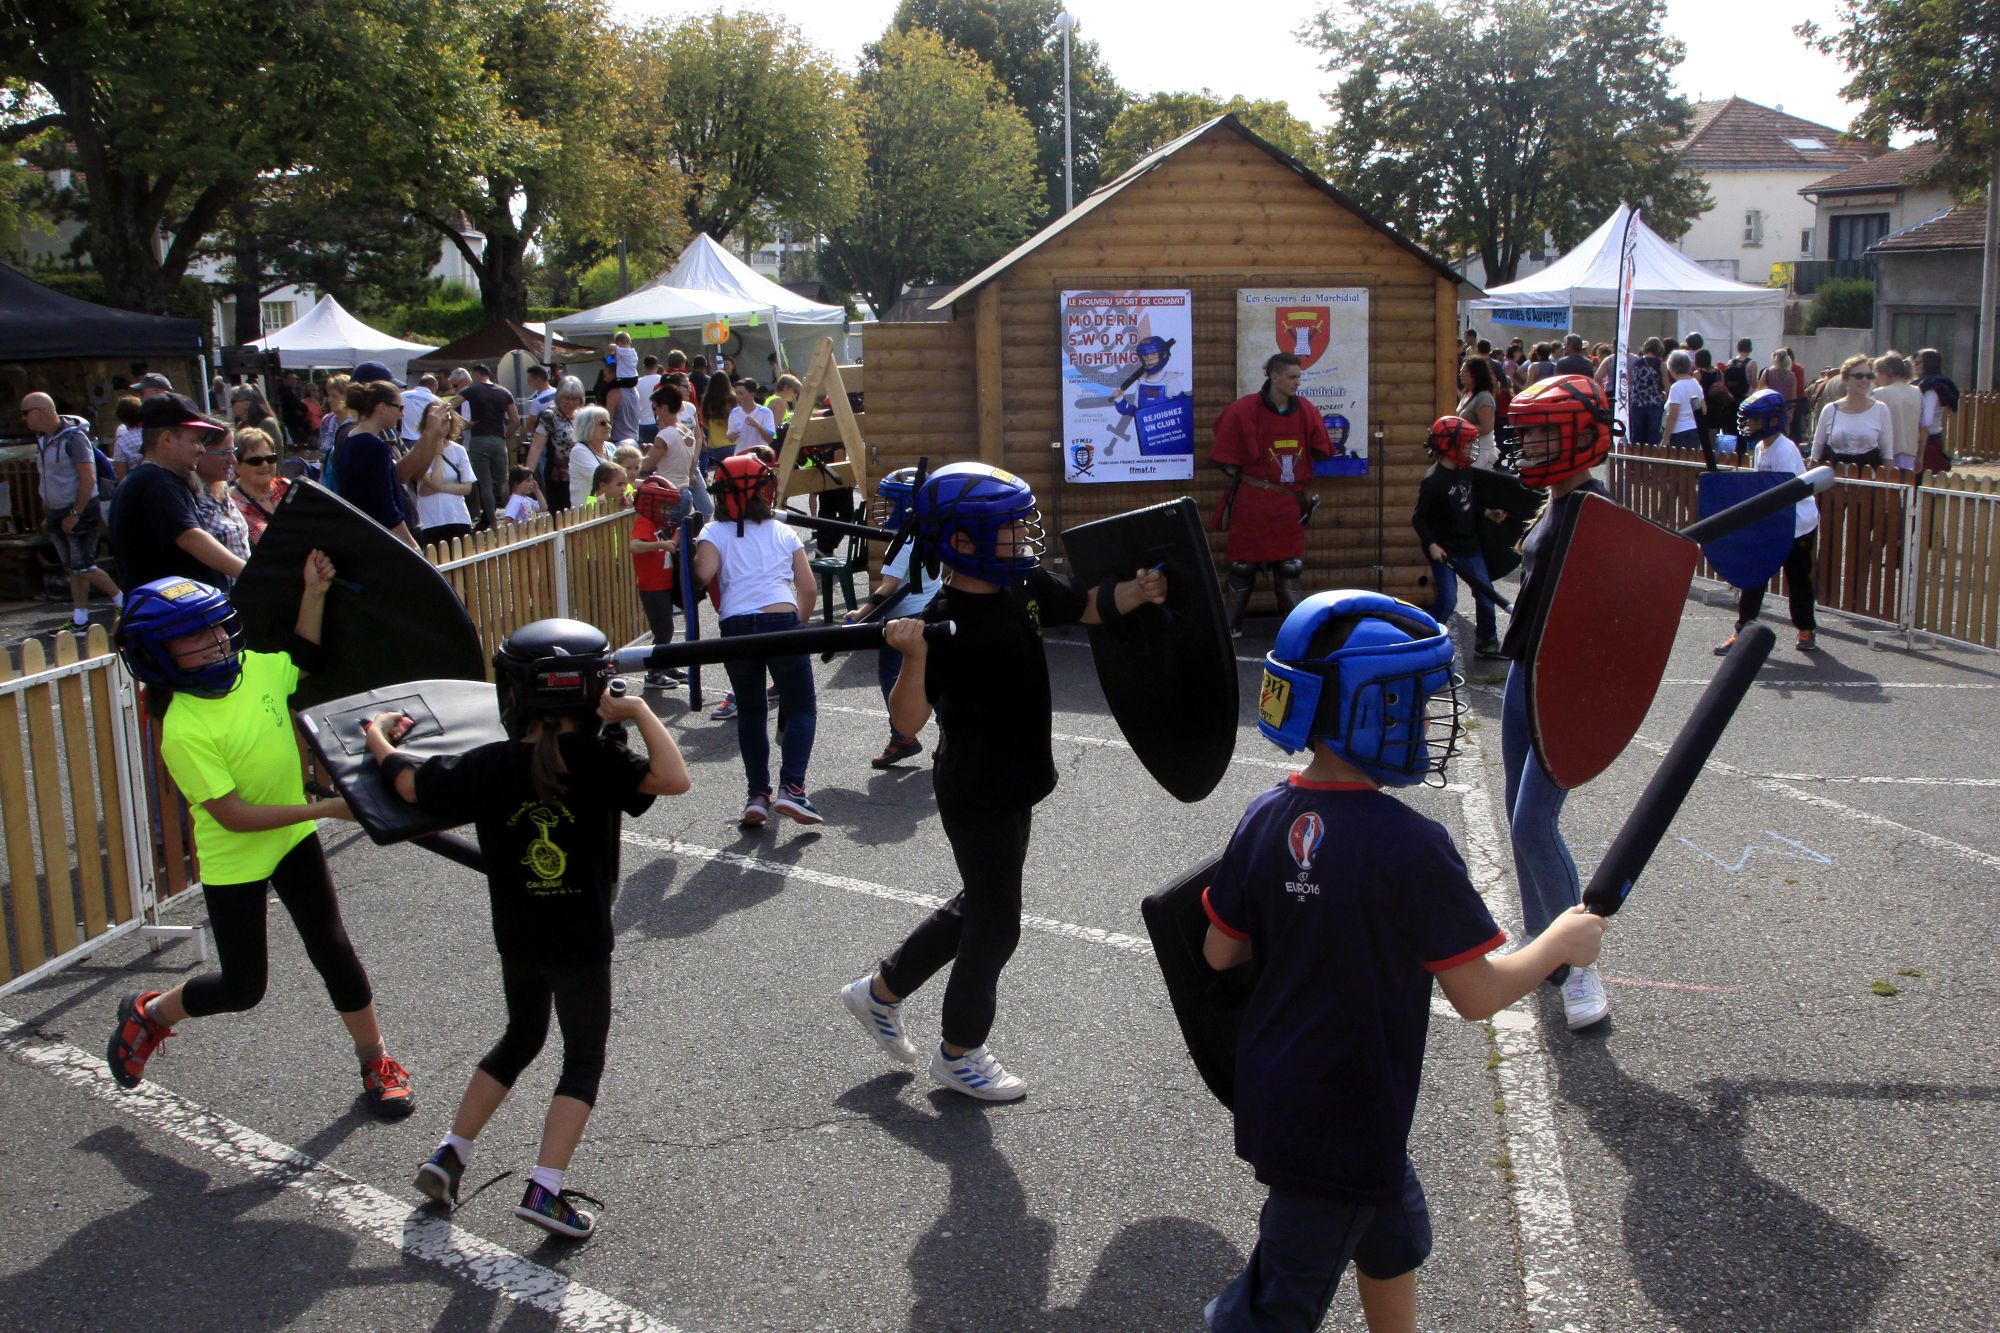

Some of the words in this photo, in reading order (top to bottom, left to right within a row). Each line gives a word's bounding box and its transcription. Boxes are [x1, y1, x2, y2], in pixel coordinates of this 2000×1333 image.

[1068, 298, 1076, 306] LE
[1078, 298, 1112, 306] NOUVEAU
[1115, 297, 1138, 305] SPORT
[1142, 297, 1150, 305] DE
[1153, 297, 1184, 305] COMBAT
[1246, 294, 1260, 303] Les
[1300, 294, 1311, 302] du
[1316, 294, 1360, 302] Marchidial
[1068, 314, 1138, 326] MODERN
[1526, 308, 1567, 328] d'Auvergne
[1069, 333, 1138, 346] SWORD
[1069, 352, 1139, 365] FIGHTING
[1143, 407, 1182, 423] REJOIGNEZ
[1145, 424, 1156, 432] UN
[1157, 419, 1176, 429] CLUB
[1129, 466, 1156, 474] ffmsf.fr
[1264, 674, 1284, 702] ЭЙ
[1285, 882, 1320, 895] EURO16
